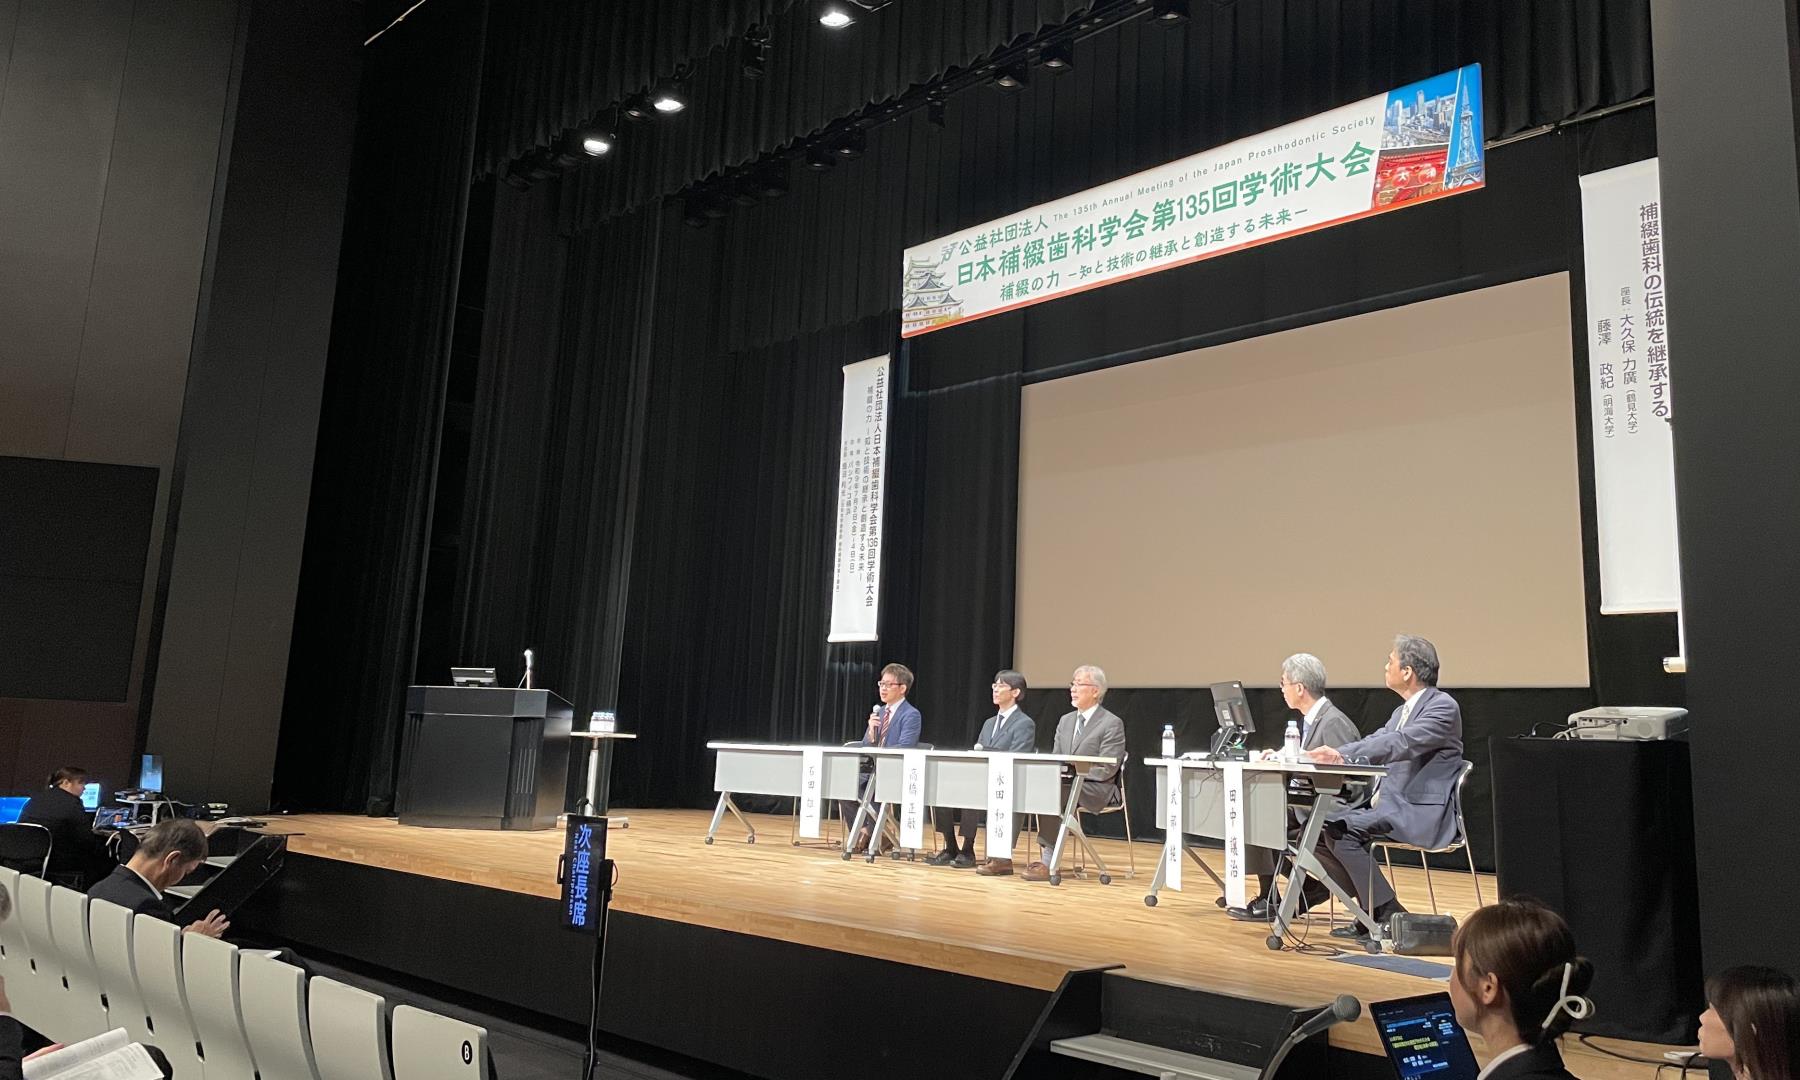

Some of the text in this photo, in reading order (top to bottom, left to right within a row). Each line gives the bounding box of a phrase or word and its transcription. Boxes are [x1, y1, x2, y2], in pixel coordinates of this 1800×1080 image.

[957, 141, 1376, 286] 日本補綴歯科学会第135回学術大会
[1053, 115, 1376, 223] The 135th Annual Meeting of the Japan Prosthodontic Society
[959, 215, 1048, 256] 公益社団法人
[1639, 202, 1668, 417] 補綴歯科の伝統を継承する
[572, 824, 592, 926] 次座長席
